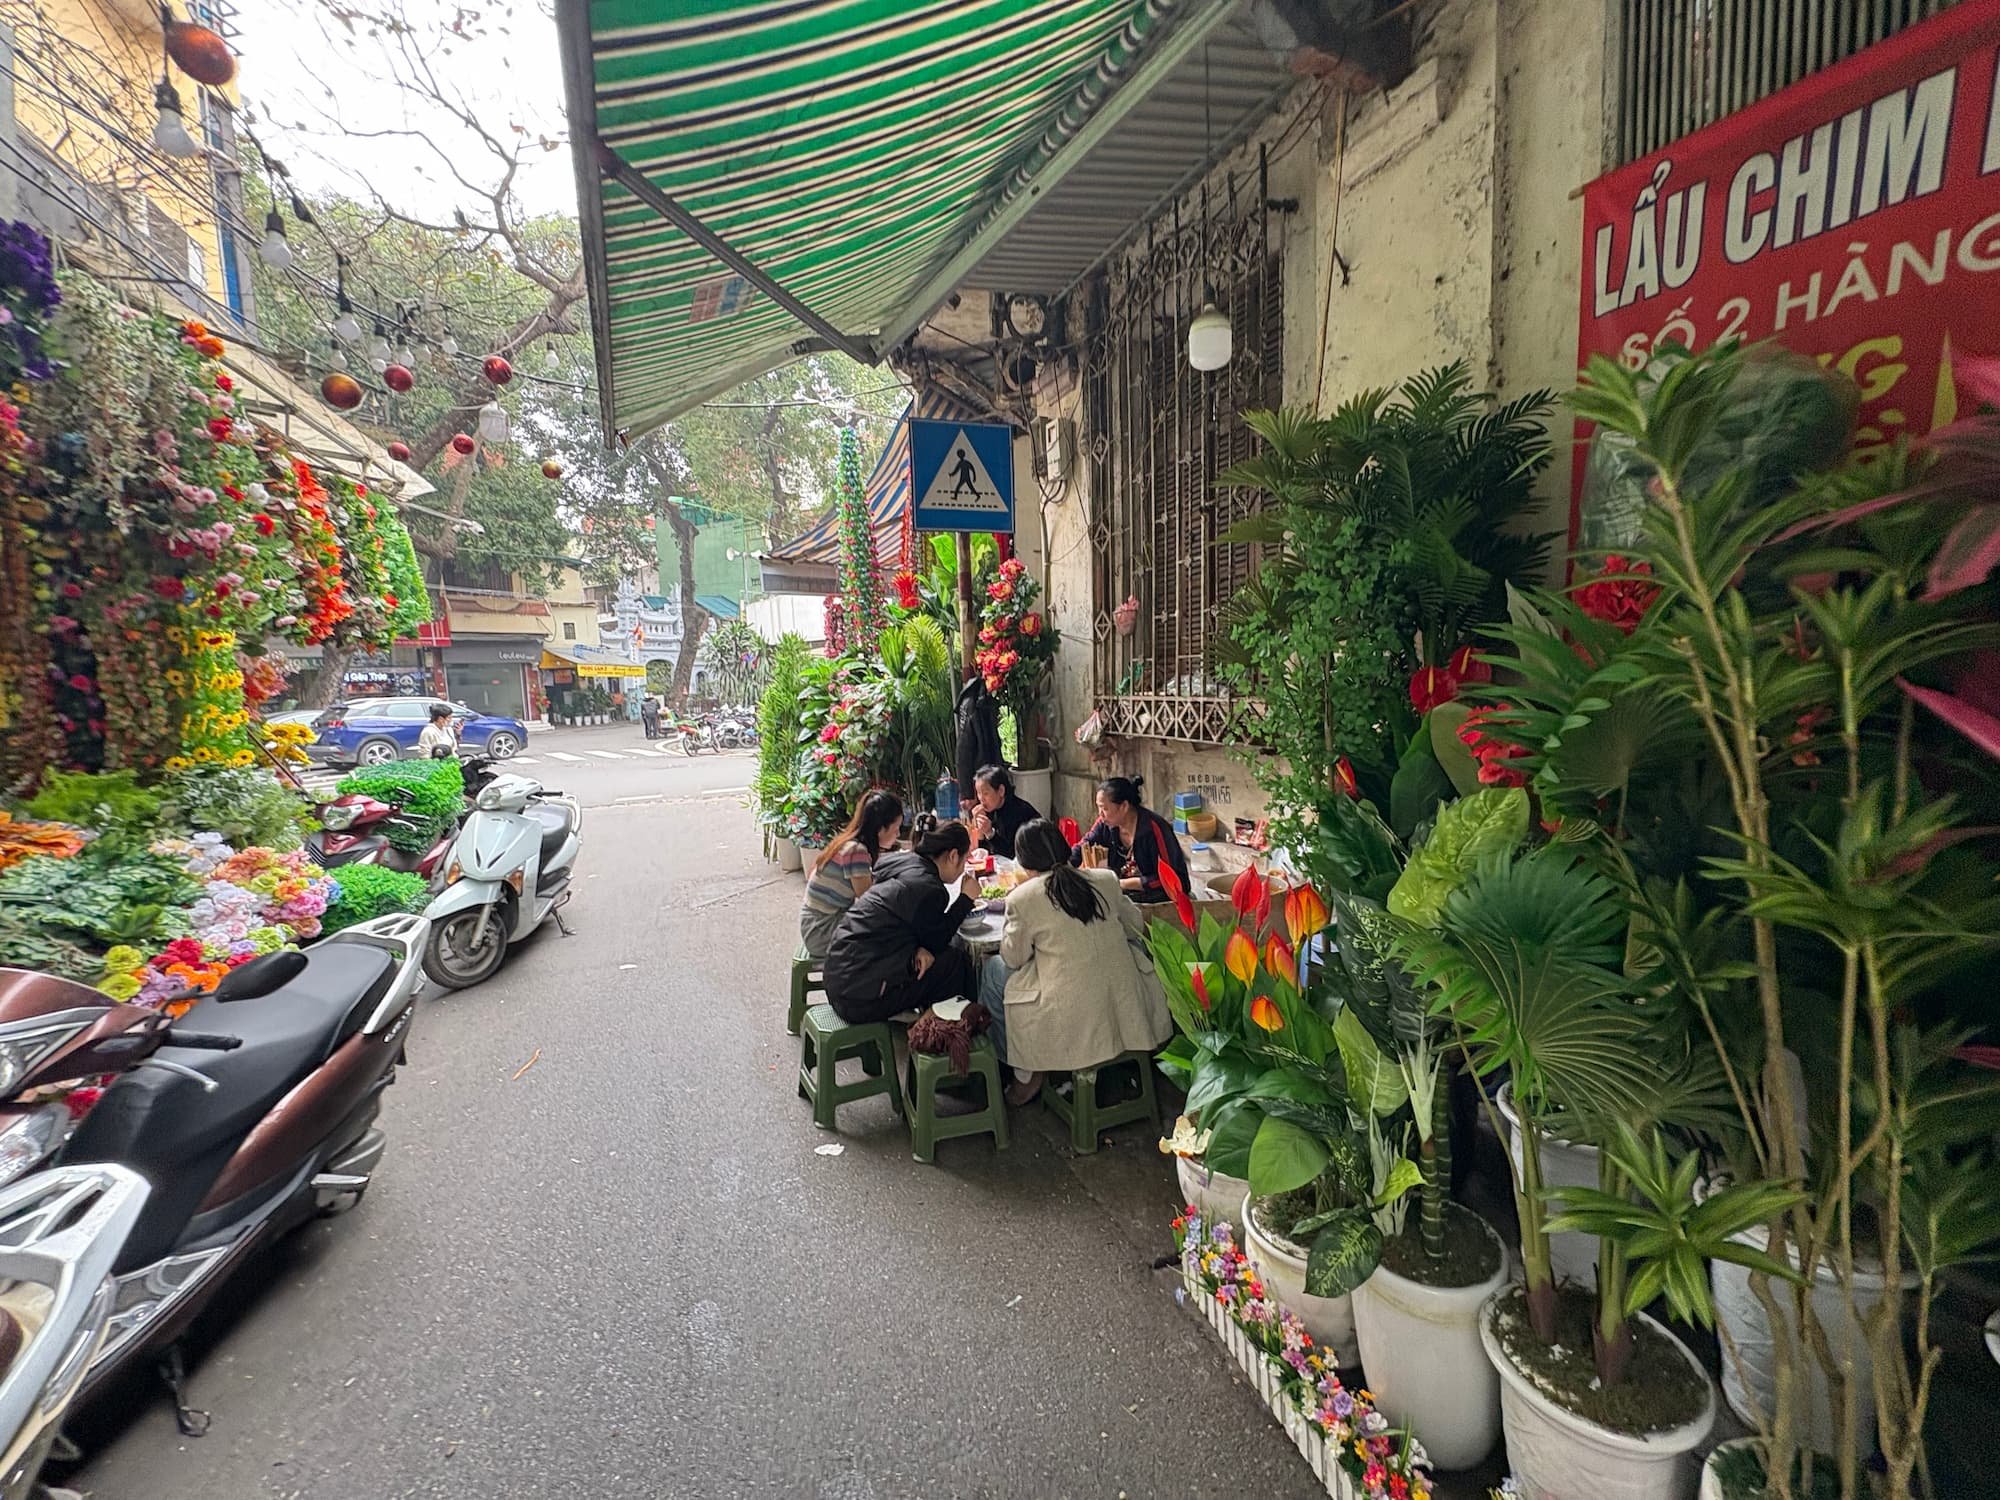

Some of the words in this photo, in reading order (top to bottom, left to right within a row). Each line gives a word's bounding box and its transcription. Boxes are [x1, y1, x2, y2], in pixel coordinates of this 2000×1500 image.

[1593, 158, 1707, 319] LẨU
[1724, 68, 1958, 266] CHIM
[1621, 297, 1697, 374] SỐ
[1716, 297, 1751, 346] 2
